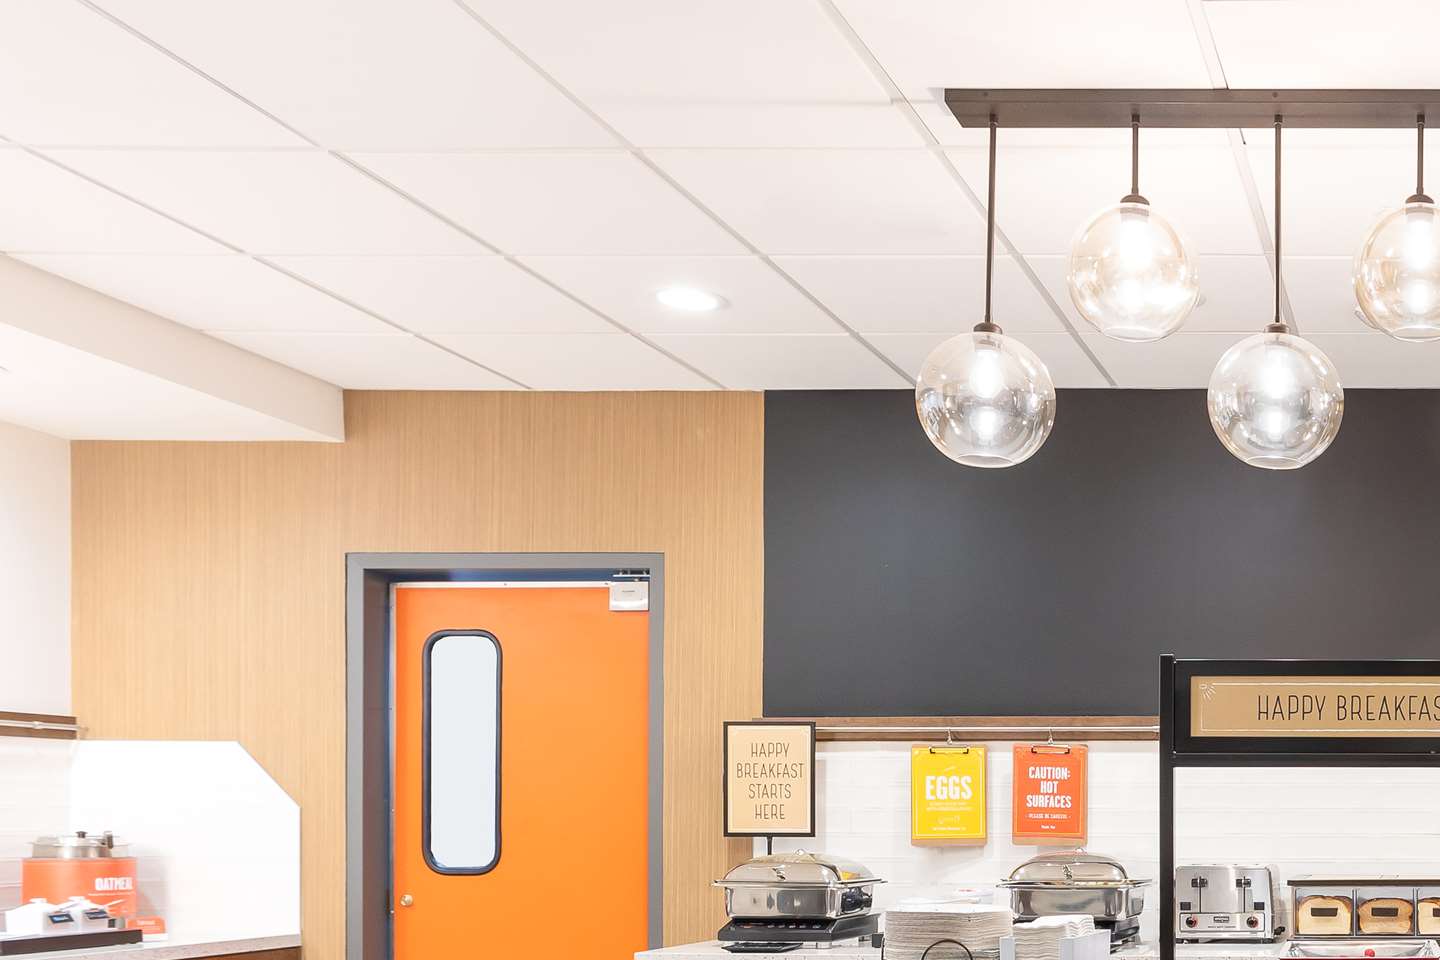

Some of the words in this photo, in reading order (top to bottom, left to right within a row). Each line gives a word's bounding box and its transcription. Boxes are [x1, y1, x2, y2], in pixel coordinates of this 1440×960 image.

[1257, 694, 1327, 721] HAPPY
[750, 742, 790, 758] HAPPY
[736, 762, 805, 779] BREAKFAST
[1028, 766, 1071, 780] CAUTION:
[748, 783, 792, 799] STARTS
[925, 775, 973, 801] EGGS
[1040, 780, 1059, 794] HOT
[1026, 794, 1072, 809] SURFACES
[754, 803, 786, 820] HERE
